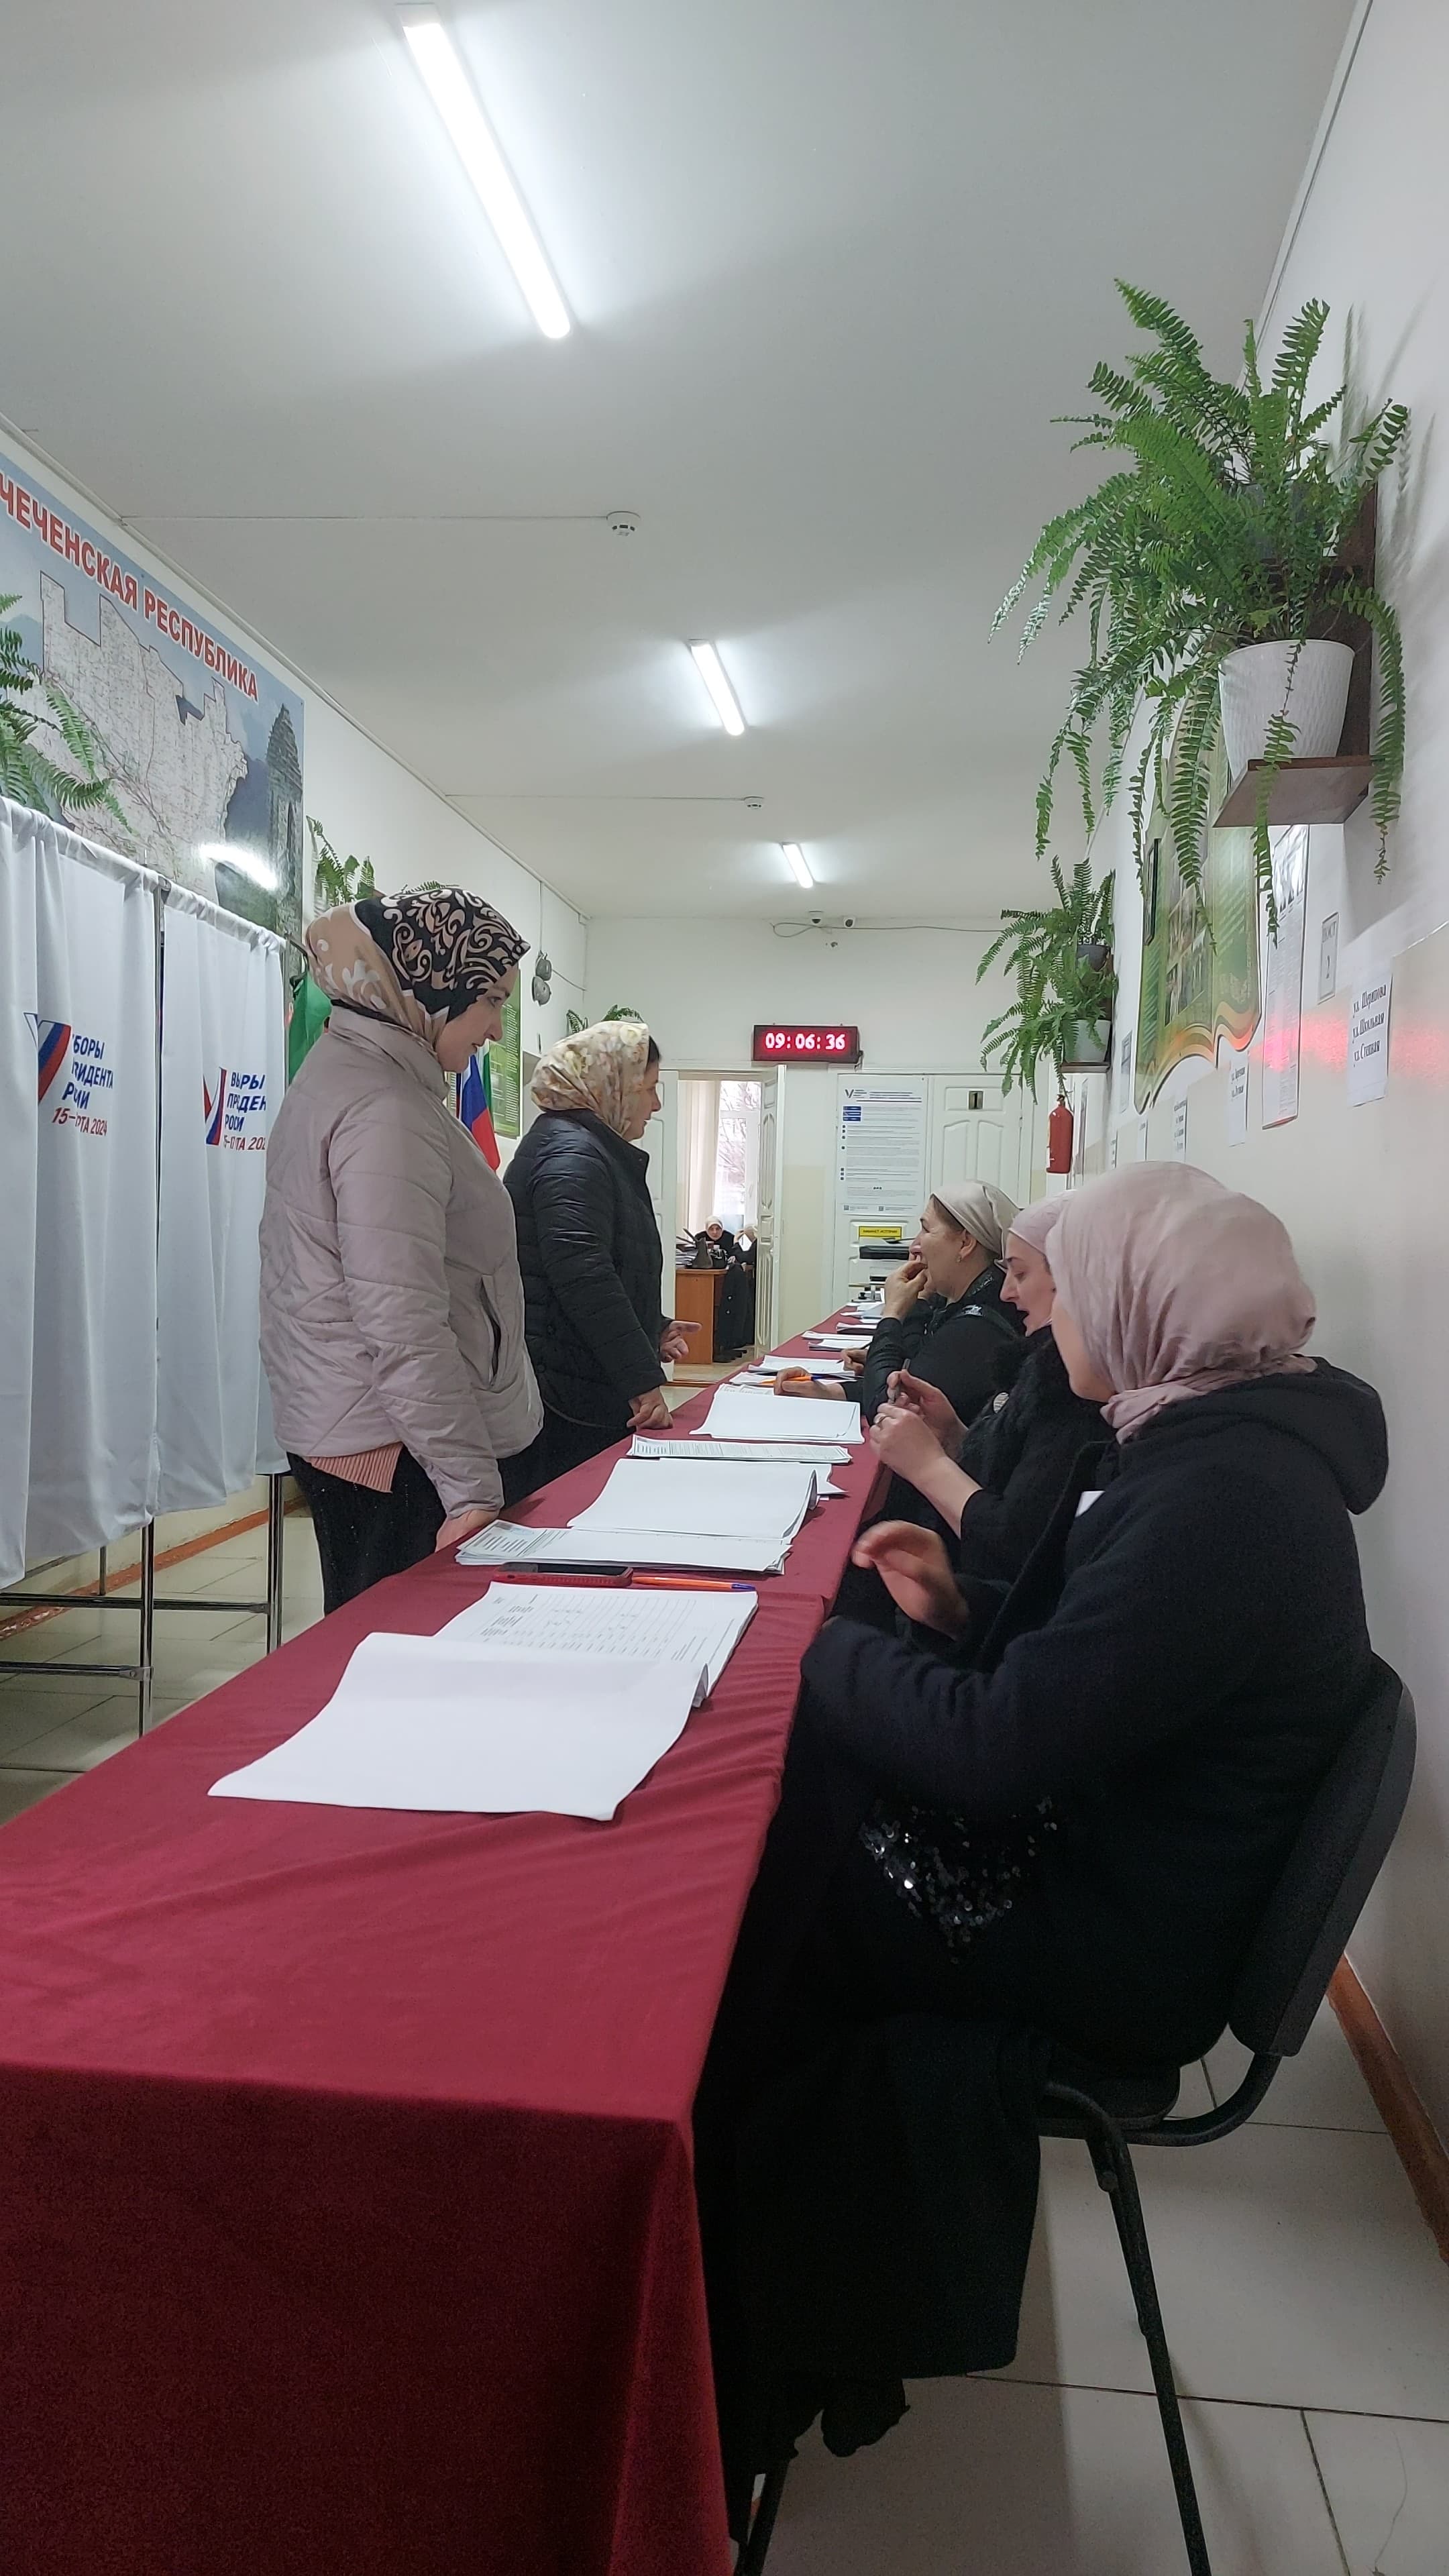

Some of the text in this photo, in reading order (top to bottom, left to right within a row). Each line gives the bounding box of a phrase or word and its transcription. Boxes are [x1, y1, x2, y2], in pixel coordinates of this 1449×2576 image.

[0, 472, 258, 702] ЧЕЧЕНСКАЯ РЕСПУБЛИКА
[765, 1033, 845, 1050] 09:06:36
